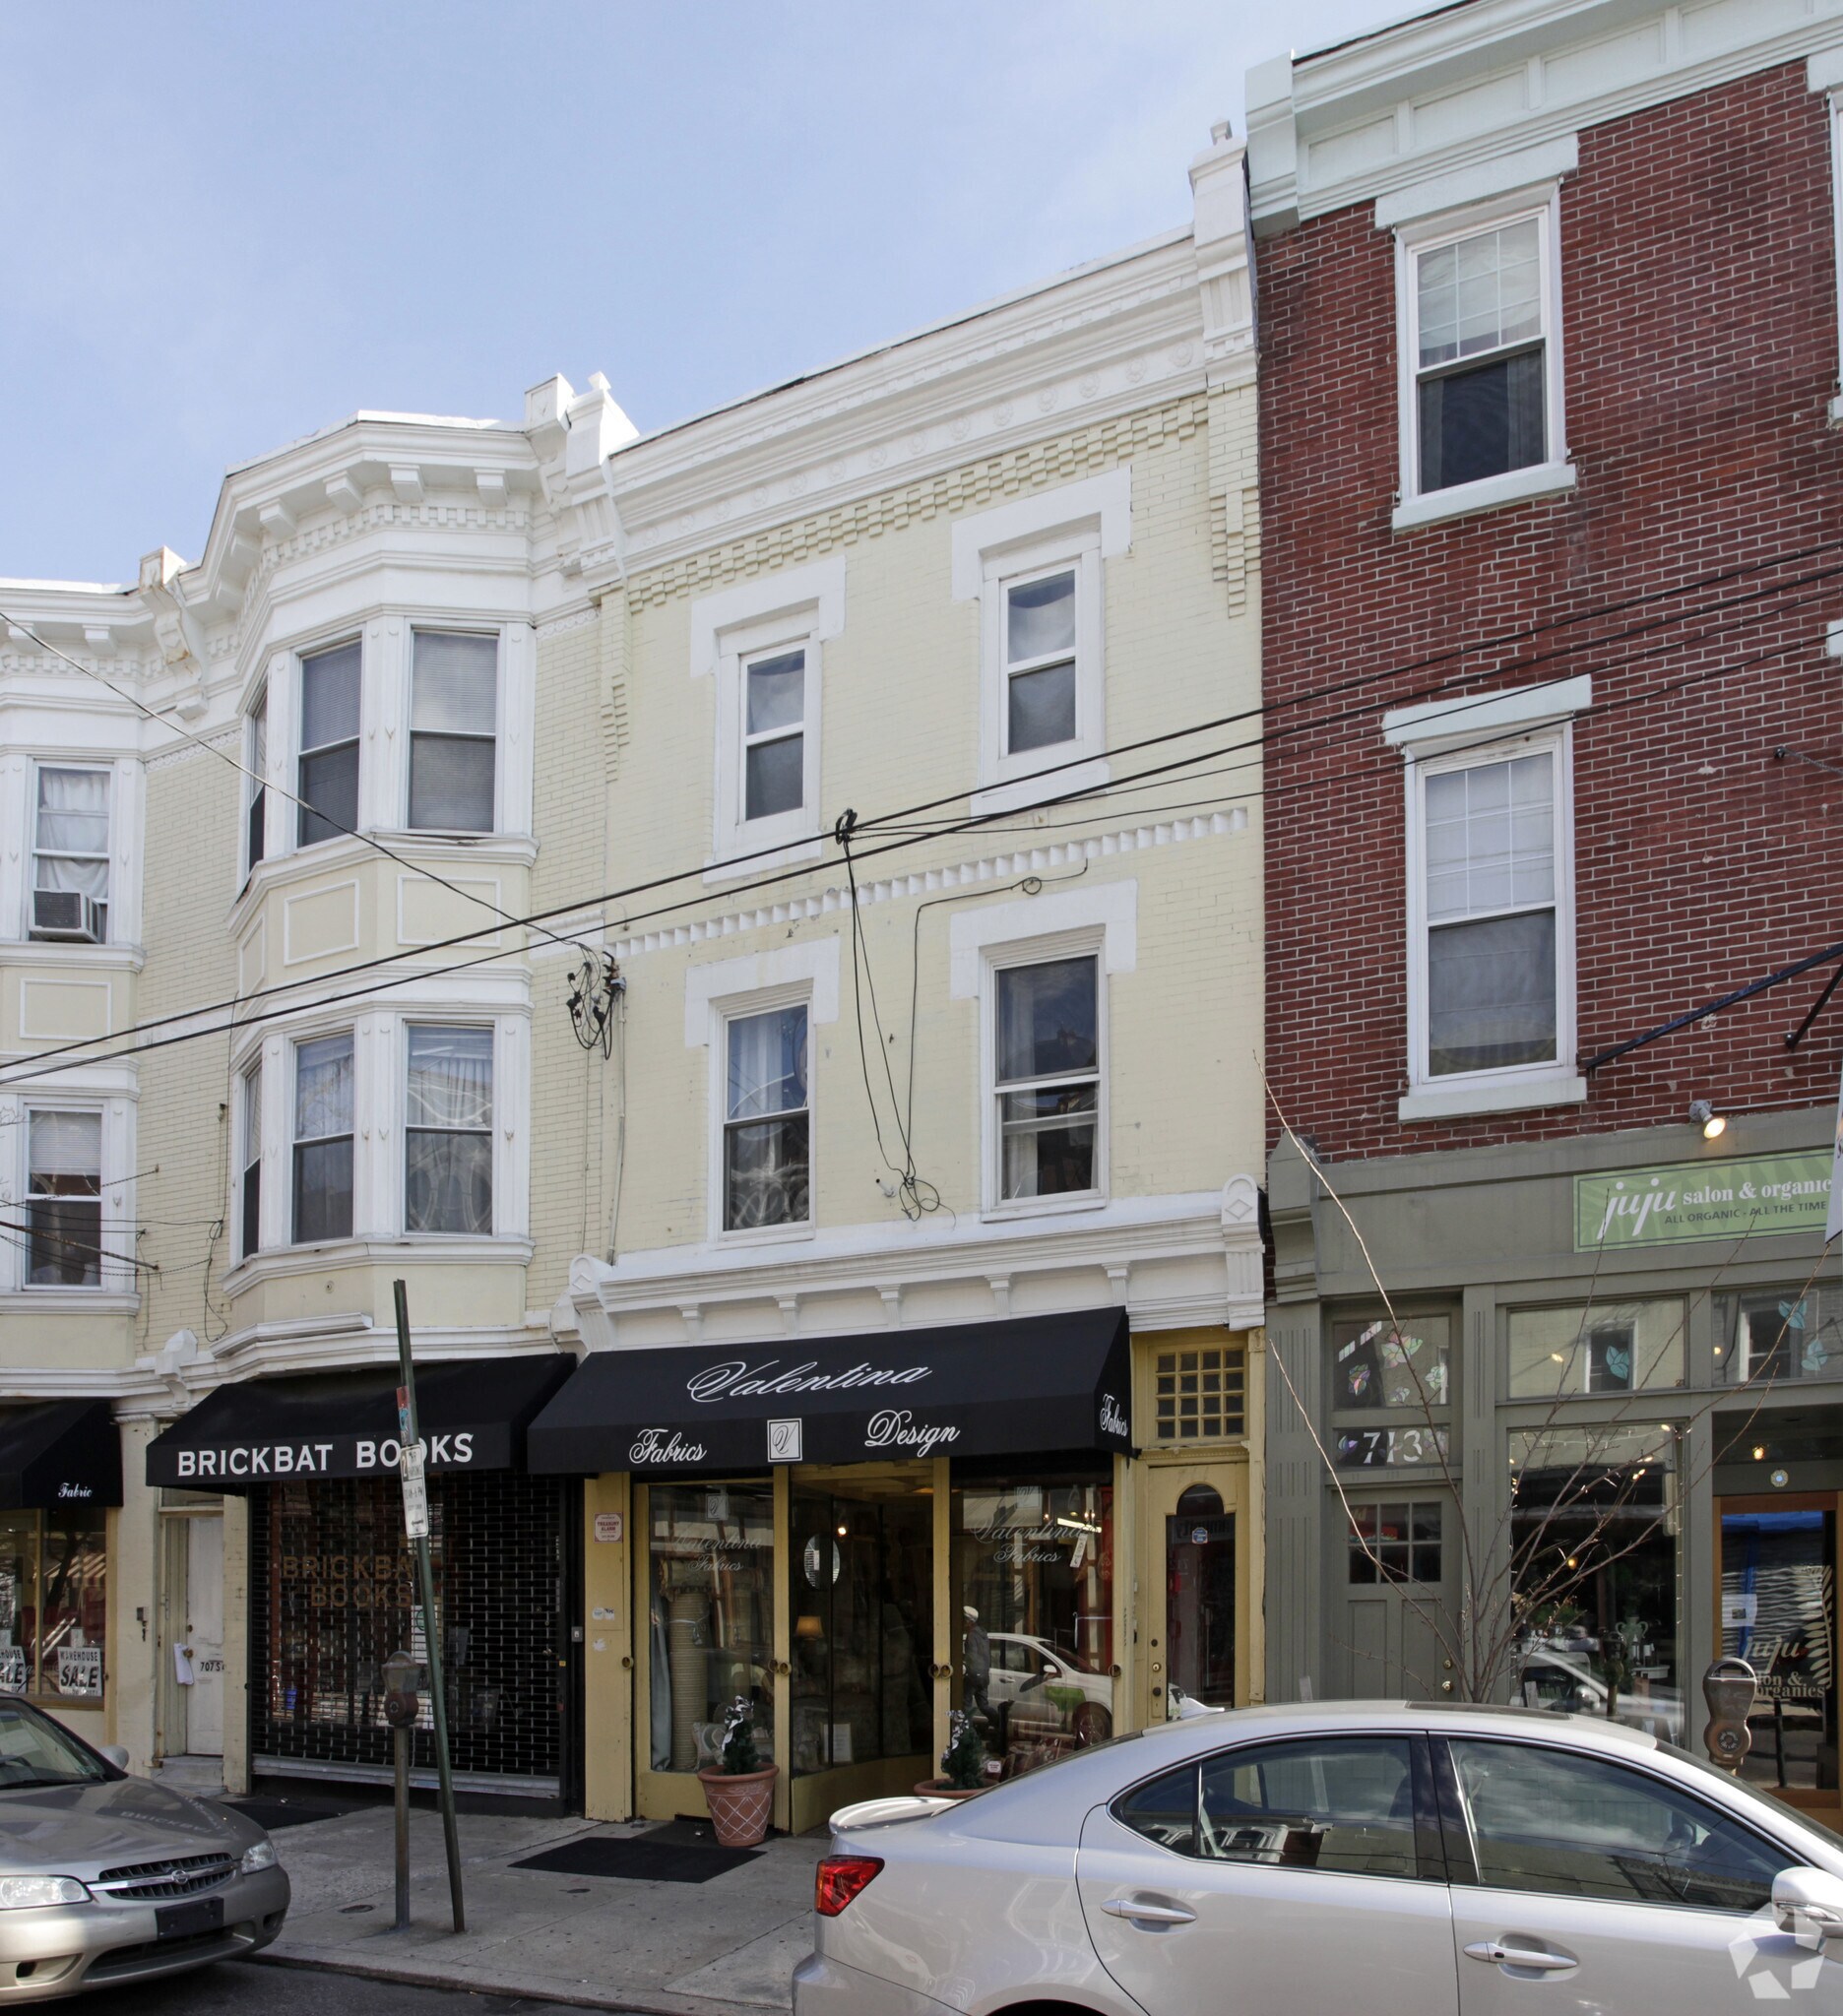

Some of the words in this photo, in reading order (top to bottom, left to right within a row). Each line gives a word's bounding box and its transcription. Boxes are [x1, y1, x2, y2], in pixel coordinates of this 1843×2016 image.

[1683, 1185, 1734, 1206] salon
[1739, 1182, 1757, 1199] &
[1761, 1178, 1832, 1201] organic
[1597, 1177, 1676, 1239] juju
[1665, 1215, 1684, 1225] ALL
[1687, 1209, 1740, 1223] ORGANIC
[1749, 1207, 1770, 1217] ALL
[1773, 1204, 1795, 1215] THE
[1798, 1201, 1826, 1212] TIME
[686, 1359, 932, 1403] Valentina
[1100, 1394, 1128, 1436] Fabrics
[628, 1428, 708, 1464] Fabrics
[864, 1410, 961, 1458] Design
[1363, 1429, 1423, 1464] 713
[177, 1443, 334, 1477] BRICKBAT
[283, 1554, 413, 1580] BRICKBA
[993, 1543, 1062, 1563] Fabrics
[310, 1583, 413, 1607] BOOKS
[61, 1665, 99, 1688] SALE
[1756, 1682, 1826, 1699] organics
